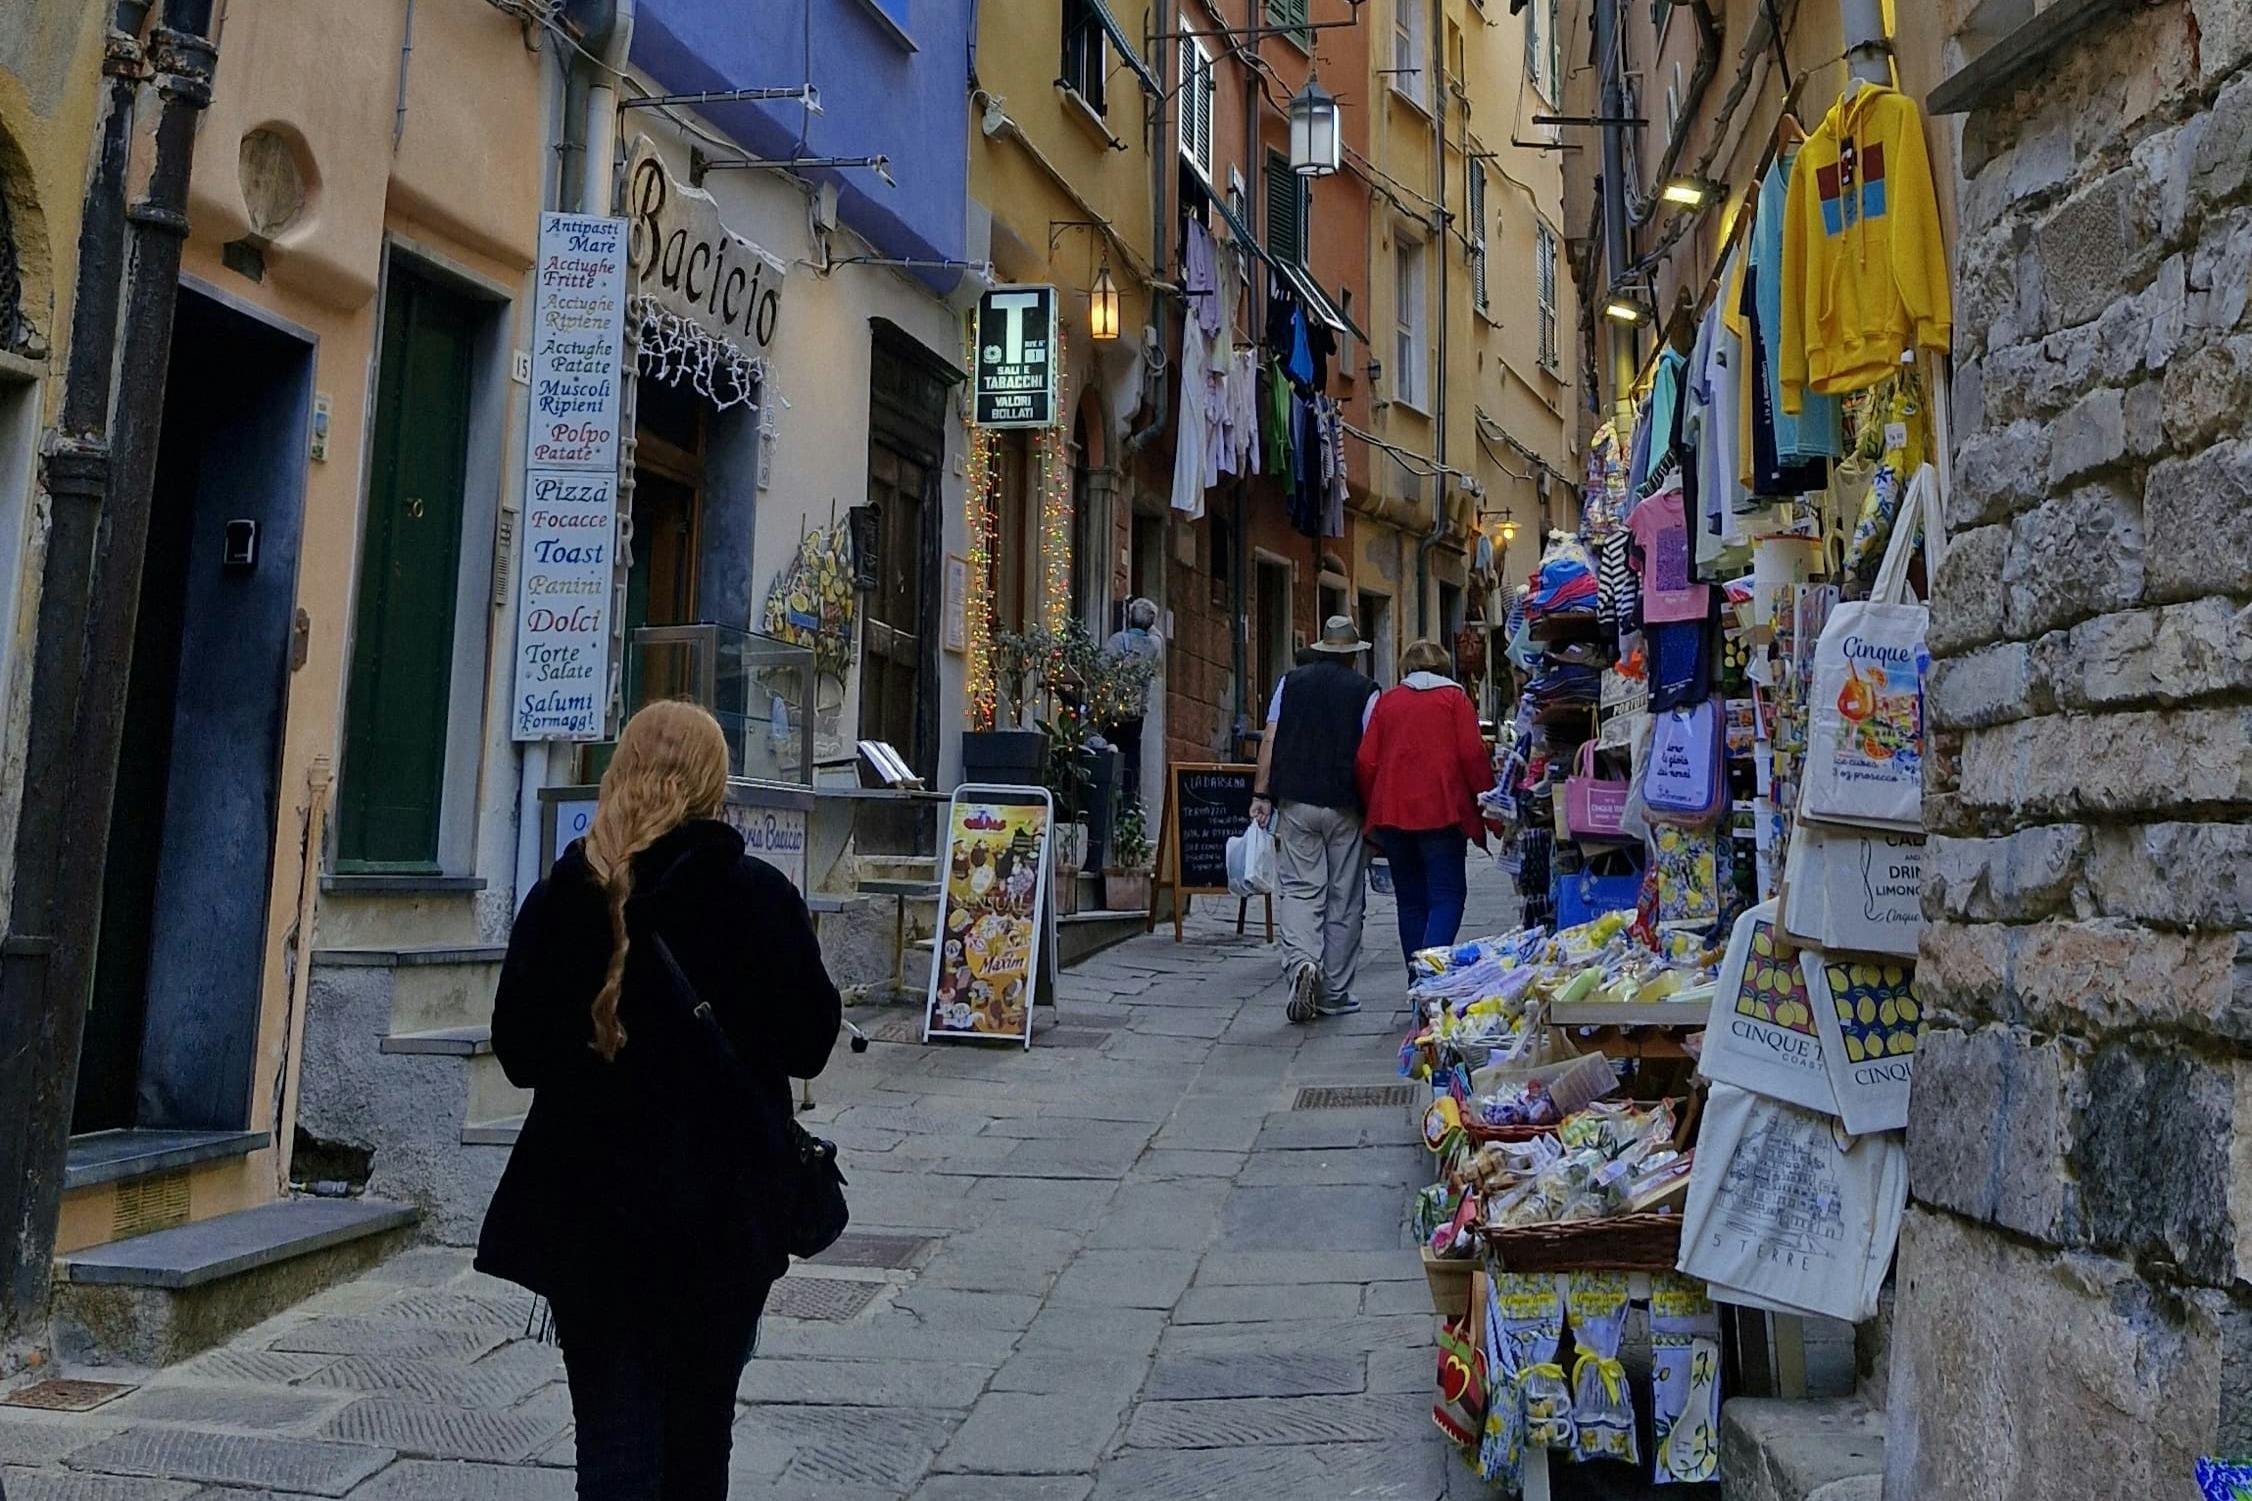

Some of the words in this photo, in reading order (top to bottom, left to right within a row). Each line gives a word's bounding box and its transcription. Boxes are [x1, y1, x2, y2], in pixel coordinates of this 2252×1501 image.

[546, 218, 619, 240] Antipasti
[568, 236, 616, 254] Mare
[632, 158, 777, 347] Bacicio
[544, 256, 616, 278] Acciughe
[543, 271, 595, 289] Fritte
[542, 294, 615, 318] Acciughe
[544, 311, 611, 334] Ripiene
[991, 293, 1039, 364] T
[539, 340, 612, 361] Acciughe
[515, 359, 529, 380] 15
[551, 356, 610, 373] Patate
[996, 366, 1019, 375] SALI
[1024, 366, 1030, 374] E
[538, 379, 610, 398] Muscoli
[984, 375, 1043, 389] TABACCHI
[540, 396, 604, 417] Ripieni
[995, 395, 1032, 407] VALORI
[991, 408, 1034, 419] BOLLATI
[551, 422, 610, 450] Polpo
[534, 444, 592, 462] Patate
[535, 479, 608, 502] Pizza
[532, 511, 607, 528] Focacce
[534, 538, 605, 564] Toast
[528, 574, 602, 596] Panini
[528, 605, 600, 633] Dolci
[525, 643, 580, 664] Torte
[1843, 636, 1911, 668] Cinque
[537, 661, 593, 682] Salate
[520, 691, 592, 715] Salumi
[520, 710, 594, 732] Formaggi
[1854, 771, 1898, 782] prosecco
[764, 813, 803, 851] Bacicio
[1886, 908, 1920, 926] Cinque
[979, 954, 1025, 975] Maxim
[1731, 1020, 1810, 1056] CINQUE
[1782, 1052, 1824, 1071] COAST
[1712, 1233, 1721, 1248] 5
[1739, 1238, 1810, 1273] TERRE
